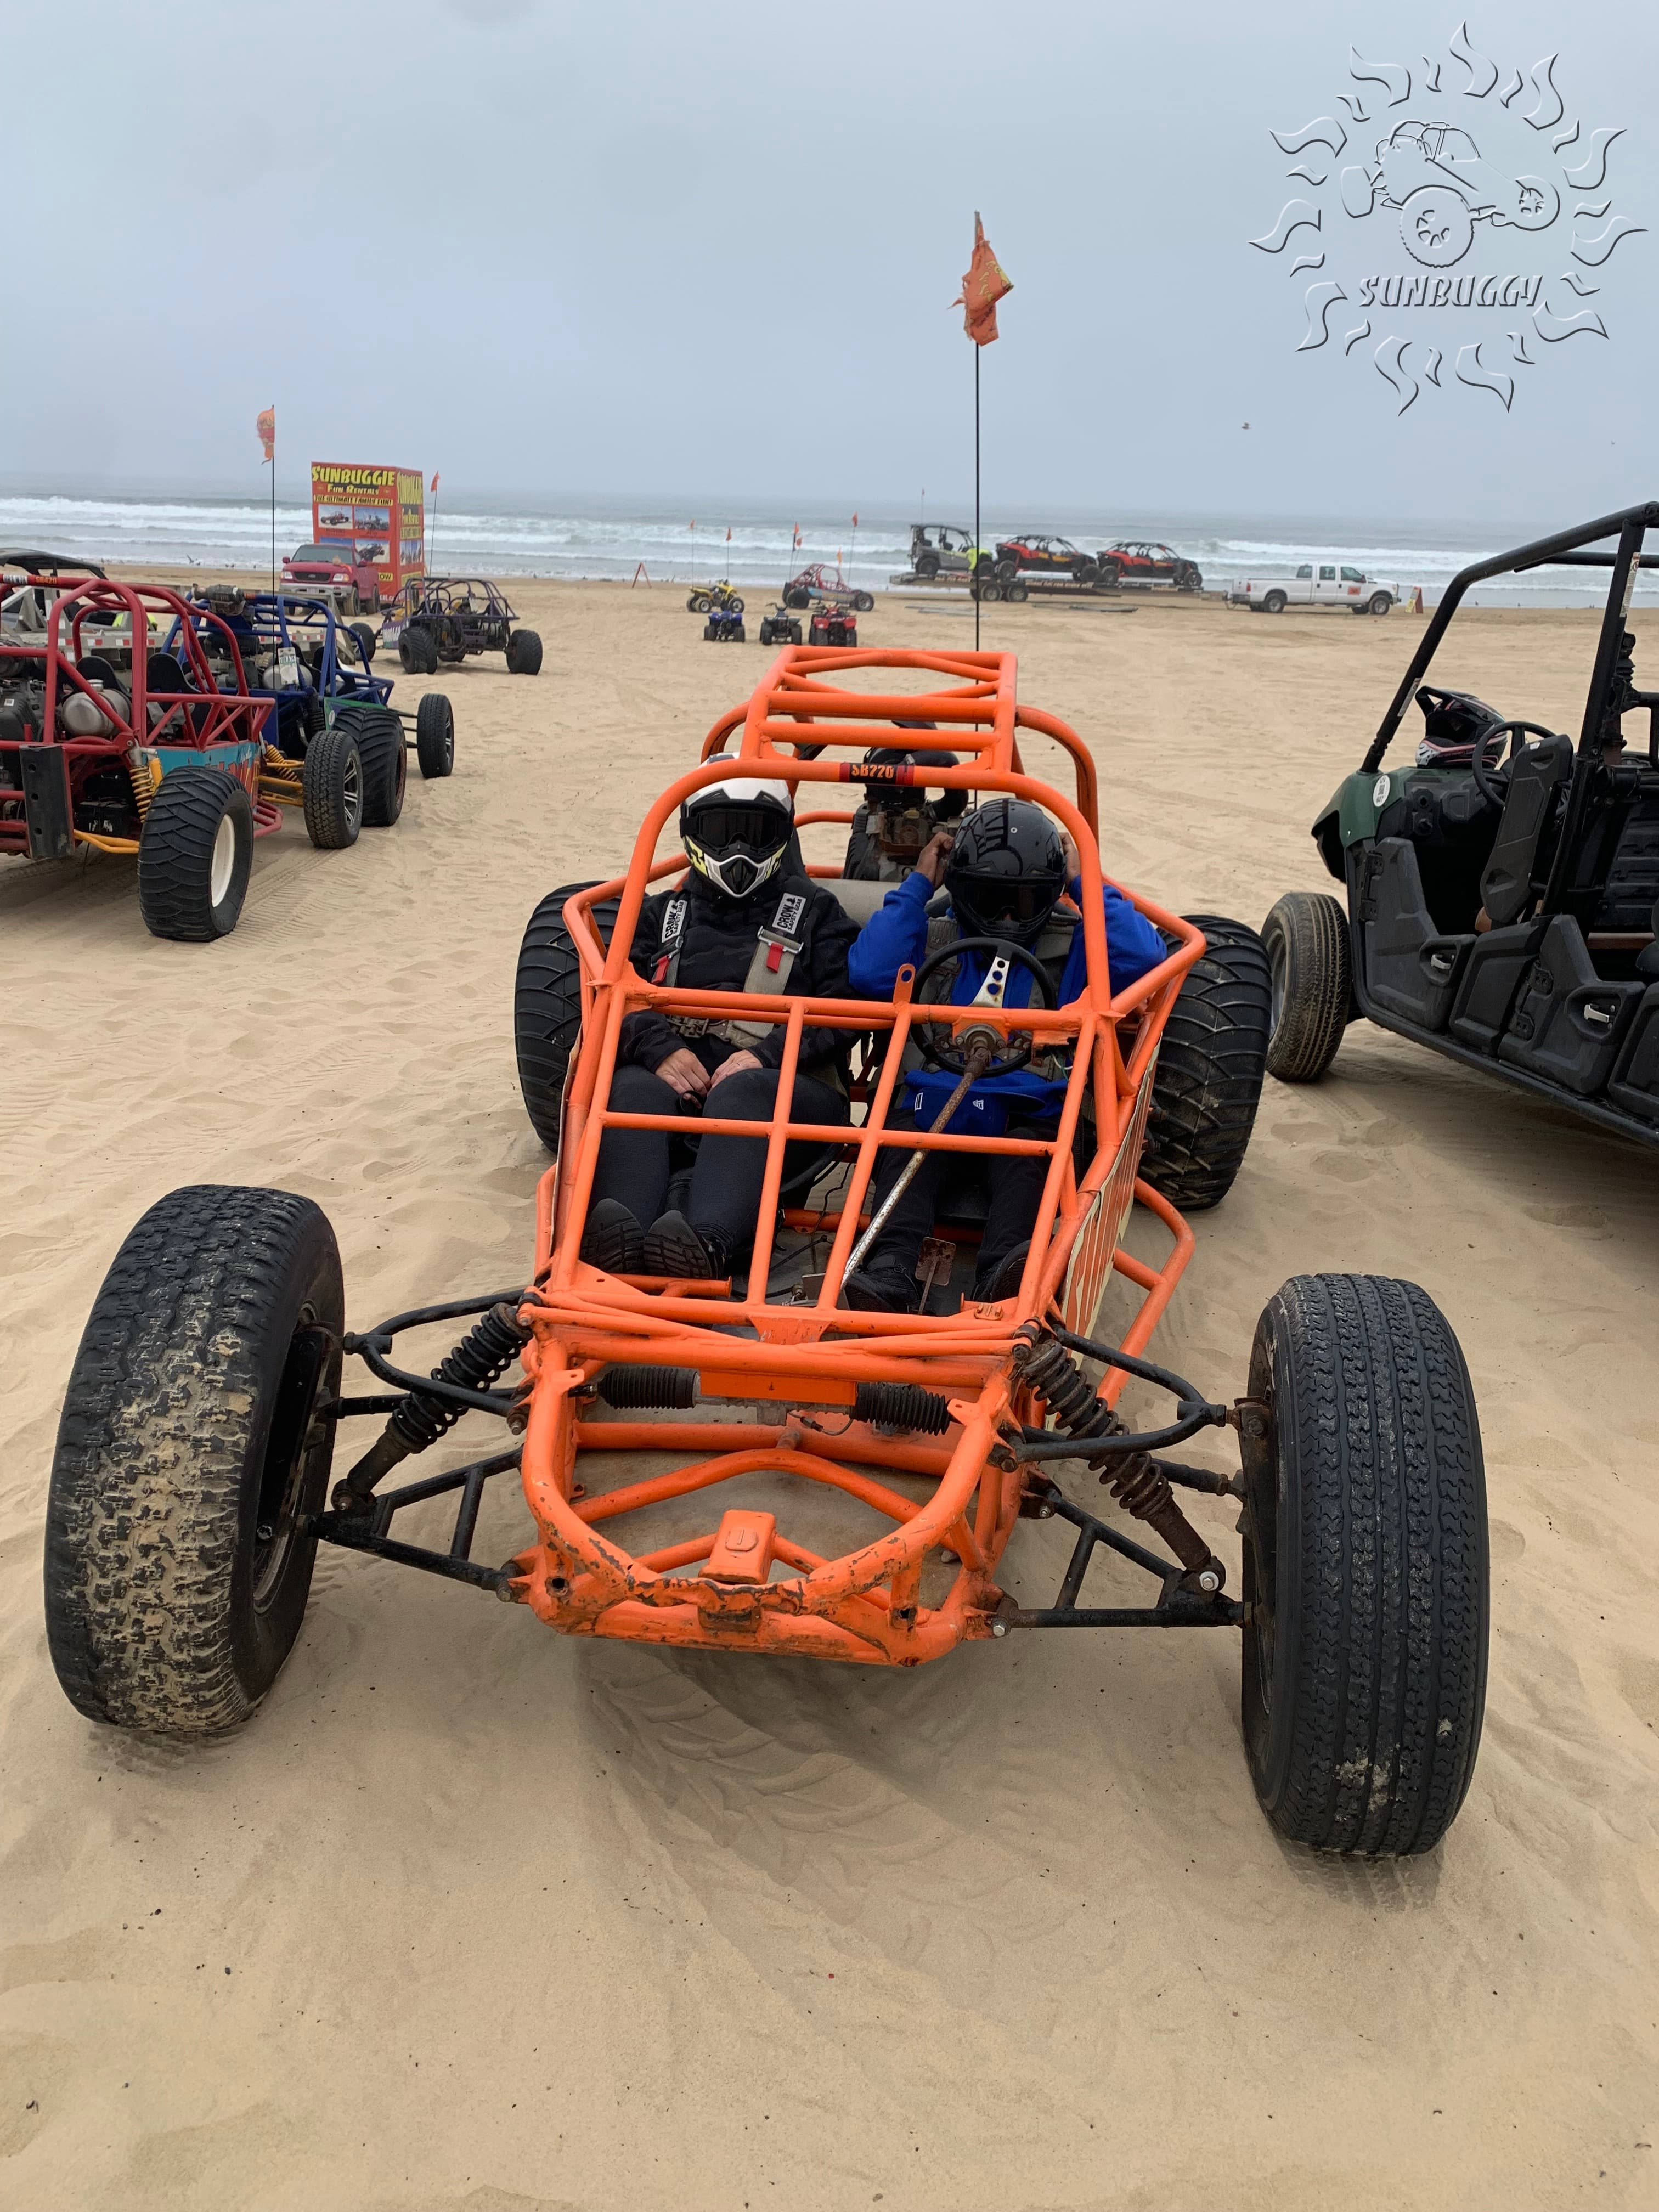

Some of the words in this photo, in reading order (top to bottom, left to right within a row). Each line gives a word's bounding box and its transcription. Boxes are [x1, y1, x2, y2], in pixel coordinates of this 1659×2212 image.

[312, 465, 396, 486] SUNBUGGIE
[326, 495, 353, 504] ULTIMATE
[851, 764, 894, 779] SB220
[777, 904, 794, 928] CROW
[788, 911, 798, 931] SAFETY
[794, 898, 803, 911] GEAR
